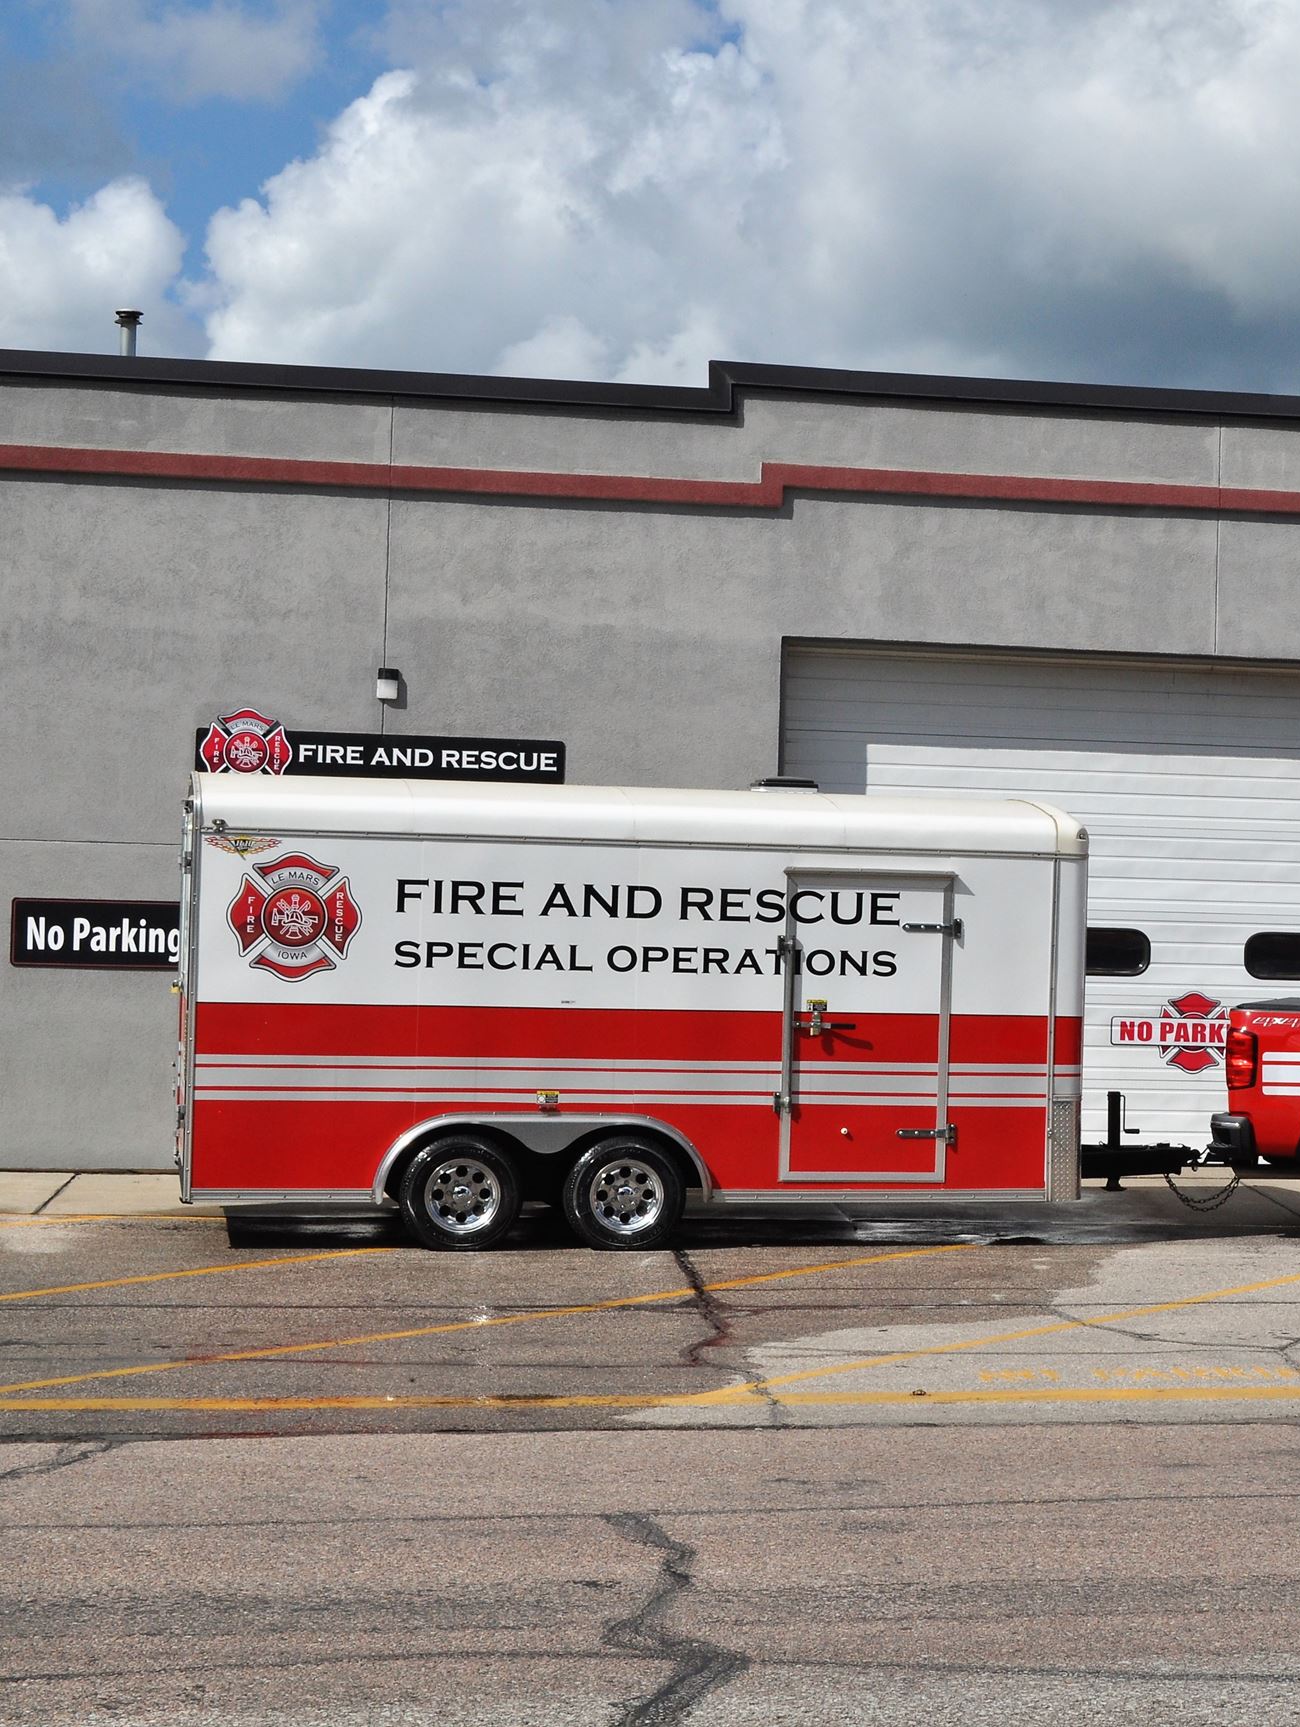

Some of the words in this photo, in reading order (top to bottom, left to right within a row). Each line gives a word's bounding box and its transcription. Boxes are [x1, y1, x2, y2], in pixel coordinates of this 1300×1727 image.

[212, 737, 221, 764] FIRE
[273, 735, 282, 771] RESCUE
[298, 744, 364, 765] FIRE
[370, 747, 434, 767] AND
[441, 750, 558, 772] RESCUE
[270, 872, 286, 886] LE
[287, 871, 321, 886] MARS
[246, 896, 256, 934] FIRE
[334, 892, 344, 942] RESCUE
[395, 878, 525, 918] FIRE
[538, 882, 663, 920] AND
[678, 887, 902, 927] RESCUE
[26, 916, 65, 951] No
[72, 917, 181, 963] Parking
[276, 949, 308, 961] IOWA
[393, 940, 593, 973] SPECIAL
[606, 944, 898, 978] OPERATIONS
[1119, 1021, 1153, 1042] NO
[1159, 1022, 1230, 1044] PARK
